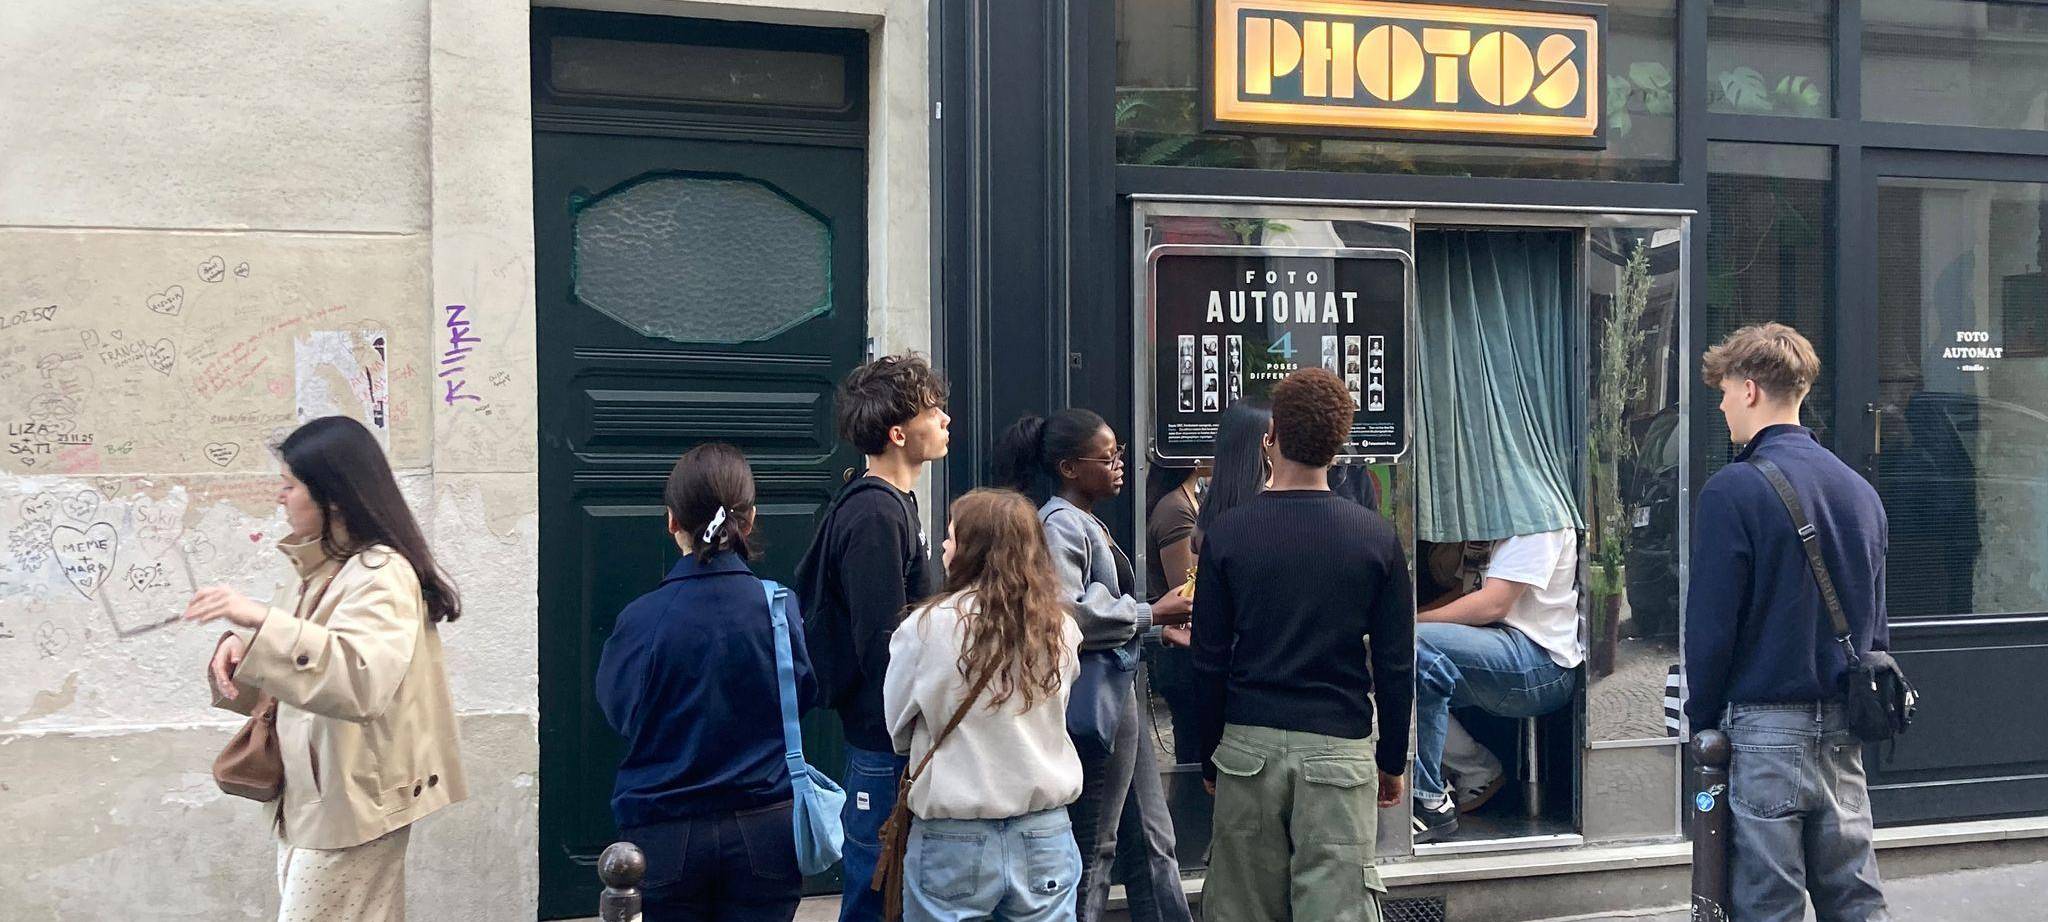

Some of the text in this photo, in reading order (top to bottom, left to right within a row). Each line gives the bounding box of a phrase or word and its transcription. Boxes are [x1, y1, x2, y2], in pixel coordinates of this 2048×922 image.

[1245, 17, 1580, 109] PHOTOS
[1245, 271, 1319, 284] FOTO
[1206, 290, 1358, 323] AUTOMAT
[1956, 331, 1989, 342] FOTO
[1267, 331, 1298, 359] 4
[1942, 347, 2003, 359] AUTOMAT
[8, 423, 48, 436] LIZA
